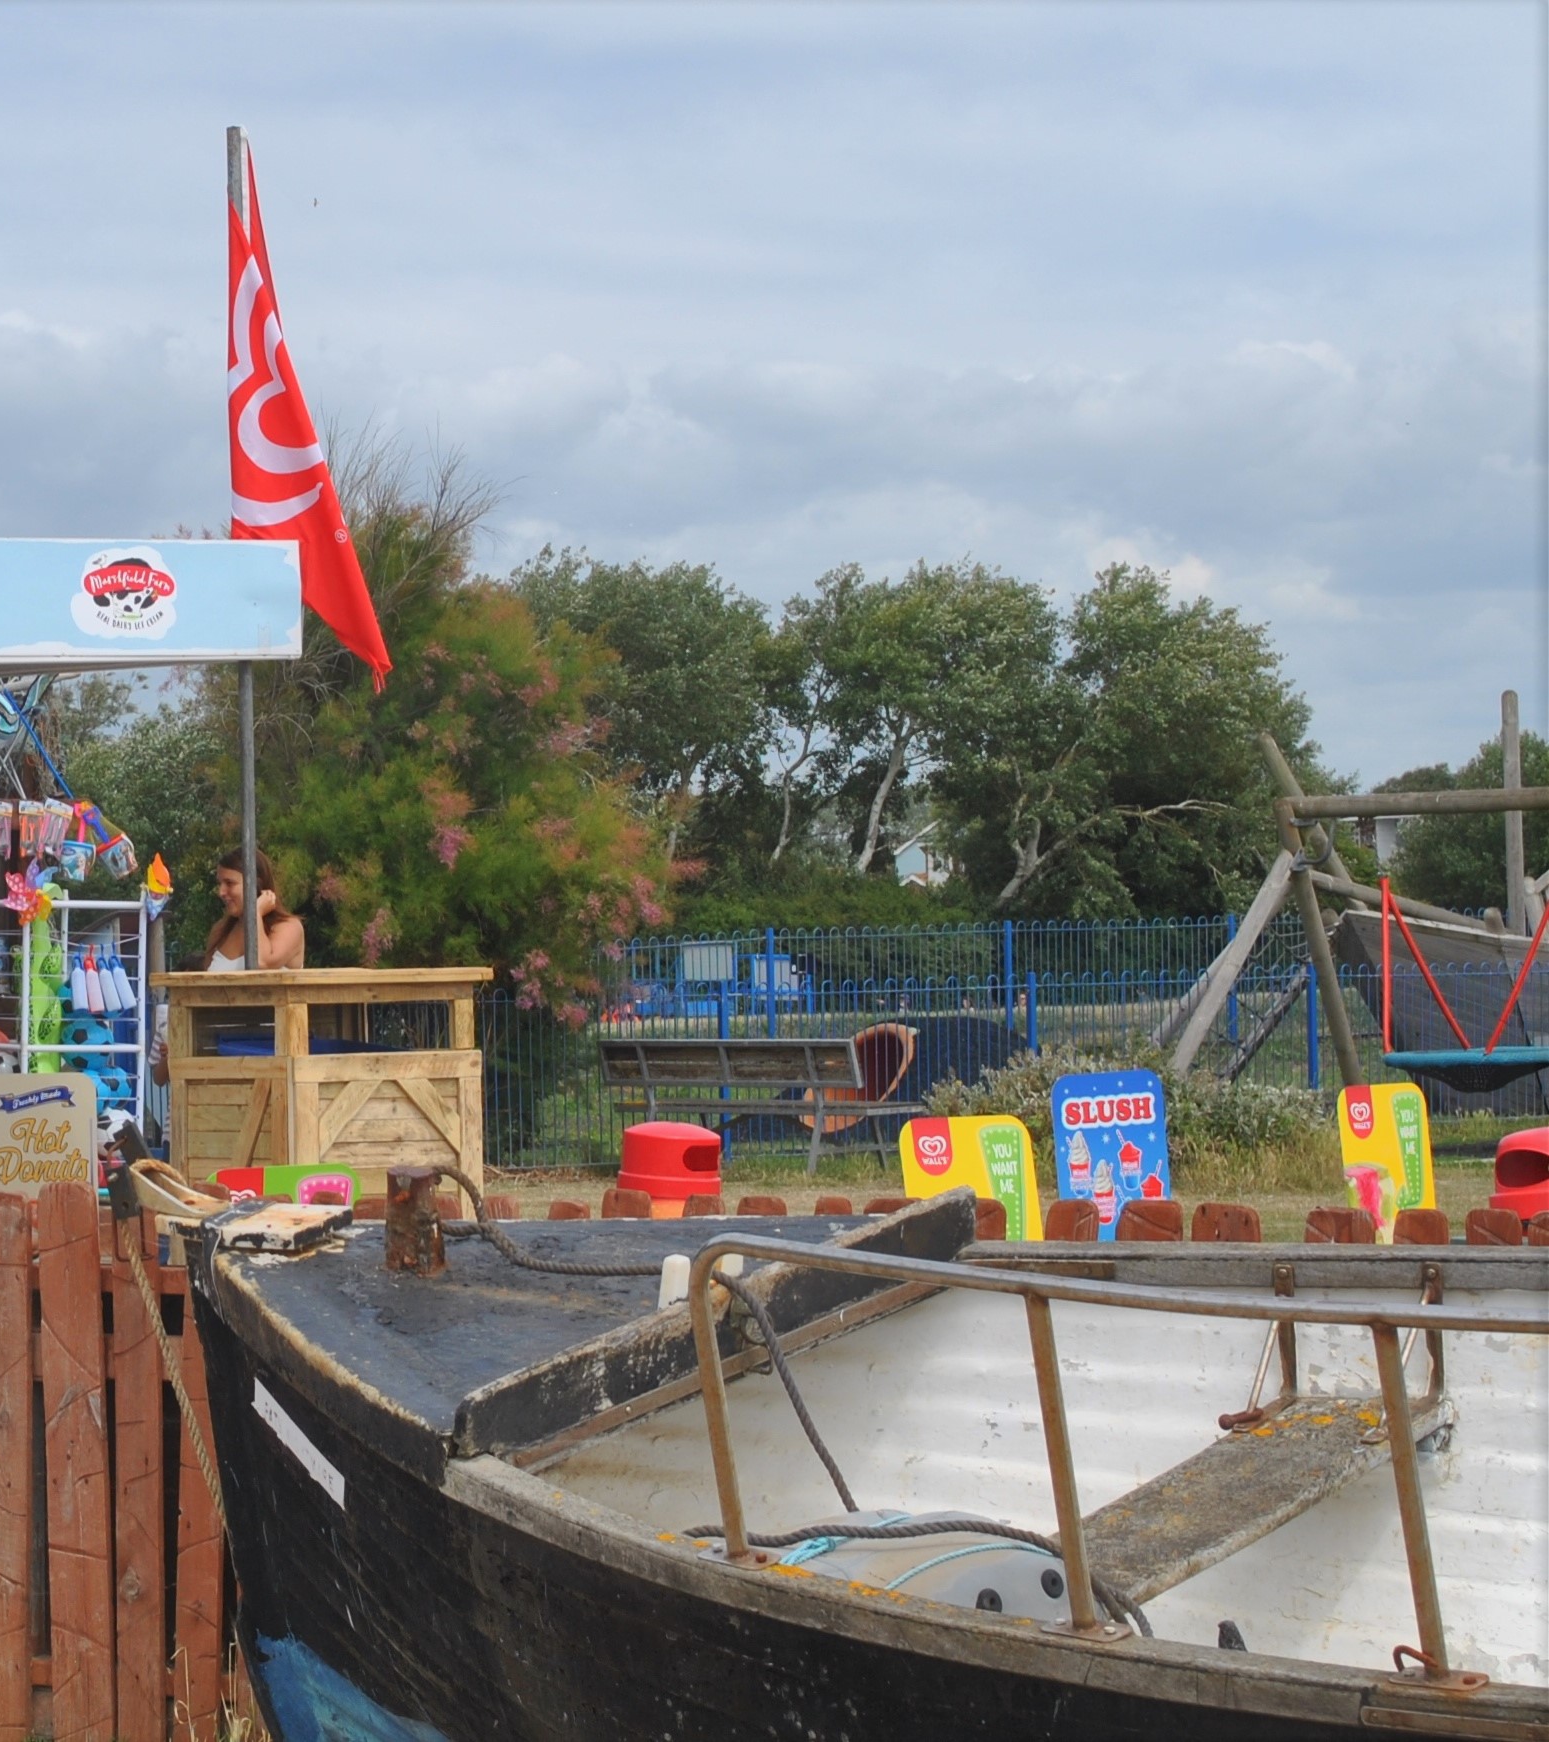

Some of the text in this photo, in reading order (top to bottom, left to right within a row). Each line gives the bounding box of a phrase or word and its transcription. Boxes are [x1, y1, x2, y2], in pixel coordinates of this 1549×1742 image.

[90, 571, 171, 593] Marshfield Farm
[96, 611, 164, 631] REAL DAIRY ICE CREAM
[12, 1089, 61, 1110] Freshly Made
[1064, 1096, 1152, 1126] SLUSH
[1401, 1109, 1414, 1122] YOU
[10, 1117, 72, 1154] Hot
[992, 1143, 1013, 1158] YOU
[991, 1161, 1018, 1176] WANT
[1000, 1179, 1015, 1194] ME
